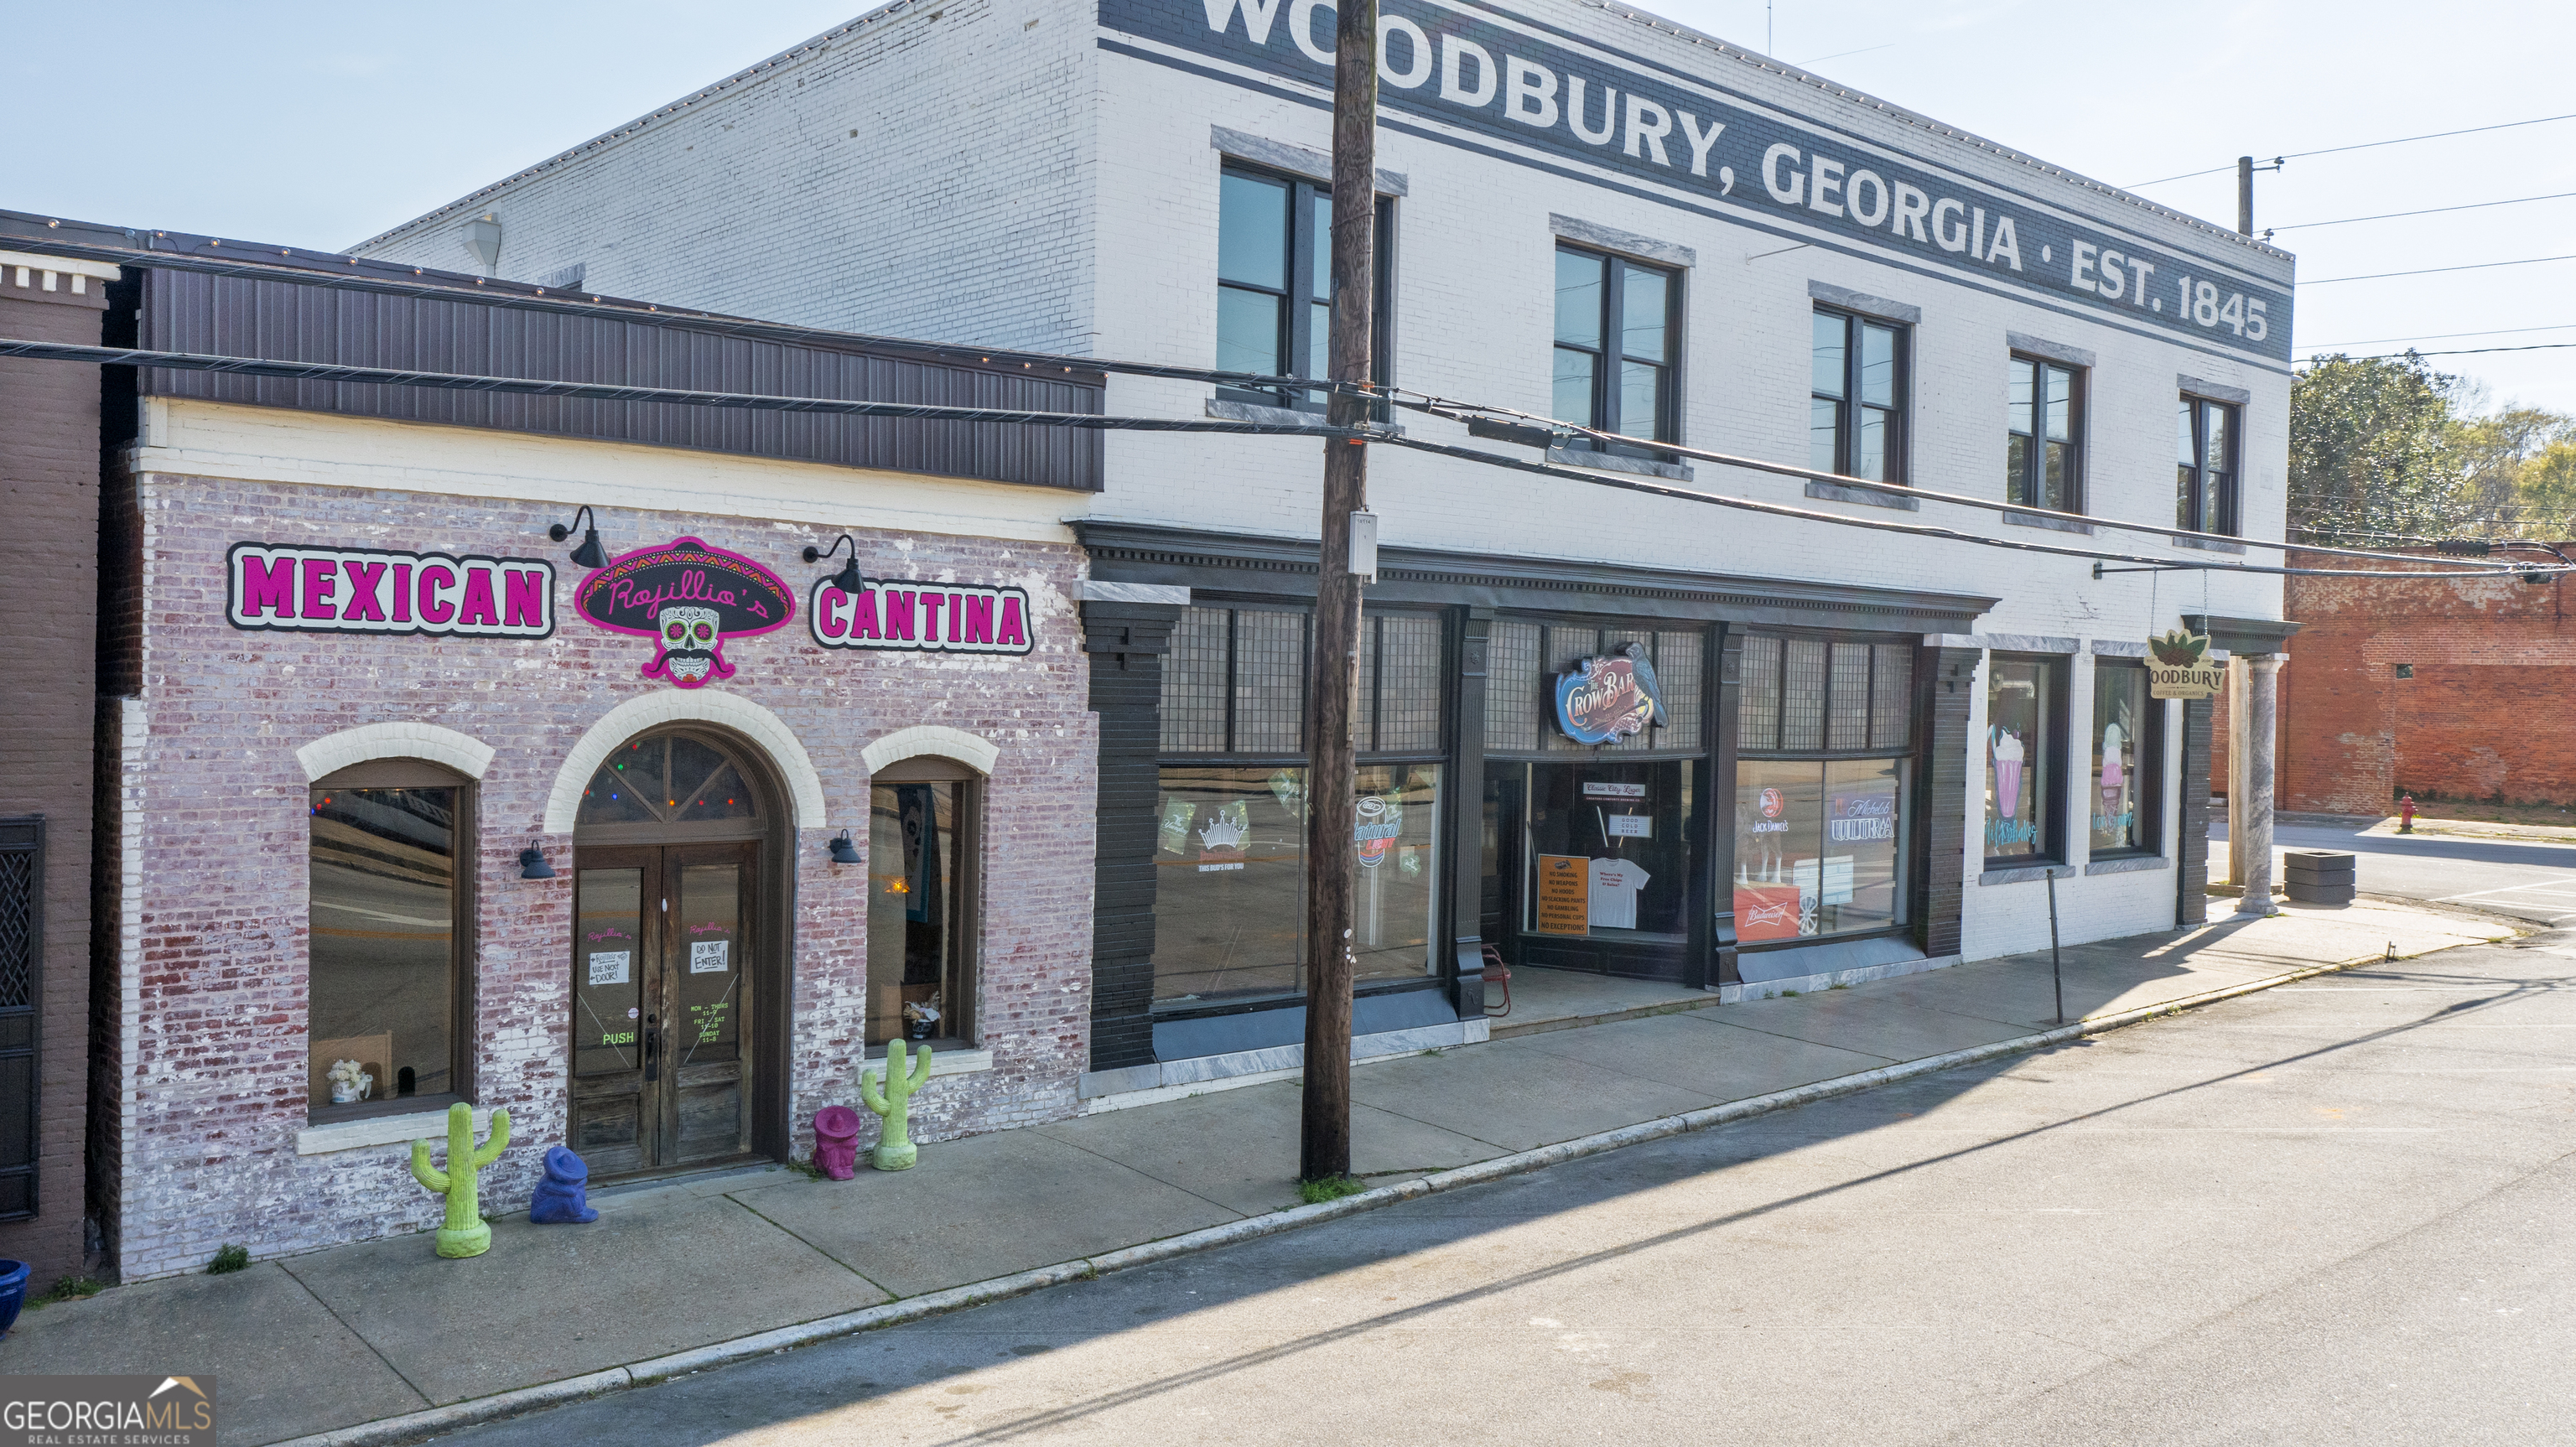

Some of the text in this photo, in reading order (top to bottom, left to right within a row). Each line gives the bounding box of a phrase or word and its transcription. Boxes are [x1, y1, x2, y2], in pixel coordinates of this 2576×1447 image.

[1202, 0, 2267, 341] WOODBURY, GEORGIA EST. 1845
[241, 554, 543, 628] MEXICAN
[609, 569, 769, 620] Rojillio's
[818, 587, 1026, 646] CANTINA
[2151, 670, 2222, 690] OODBURY
[1566, 686, 1603, 726] CROW
[1602, 672, 1635, 710] BAR
[1607, 785, 1622, 794] City
[1623, 786, 1641, 796] Lager
[1848, 799, 1891, 817] Michelob
[1831, 817, 1895, 842] ULTRA
[1748, 909, 1784, 921] Budweiser
[1550, 922, 1585, 931] EXCEPTIONS
[697, 942, 722, 953] DO NOT
[695, 950, 725, 969] ENTER!
[592, 965, 604, 973] USE
[595, 970, 618, 983] DOOR!
[603, 1032, 634, 1045] PUSH
